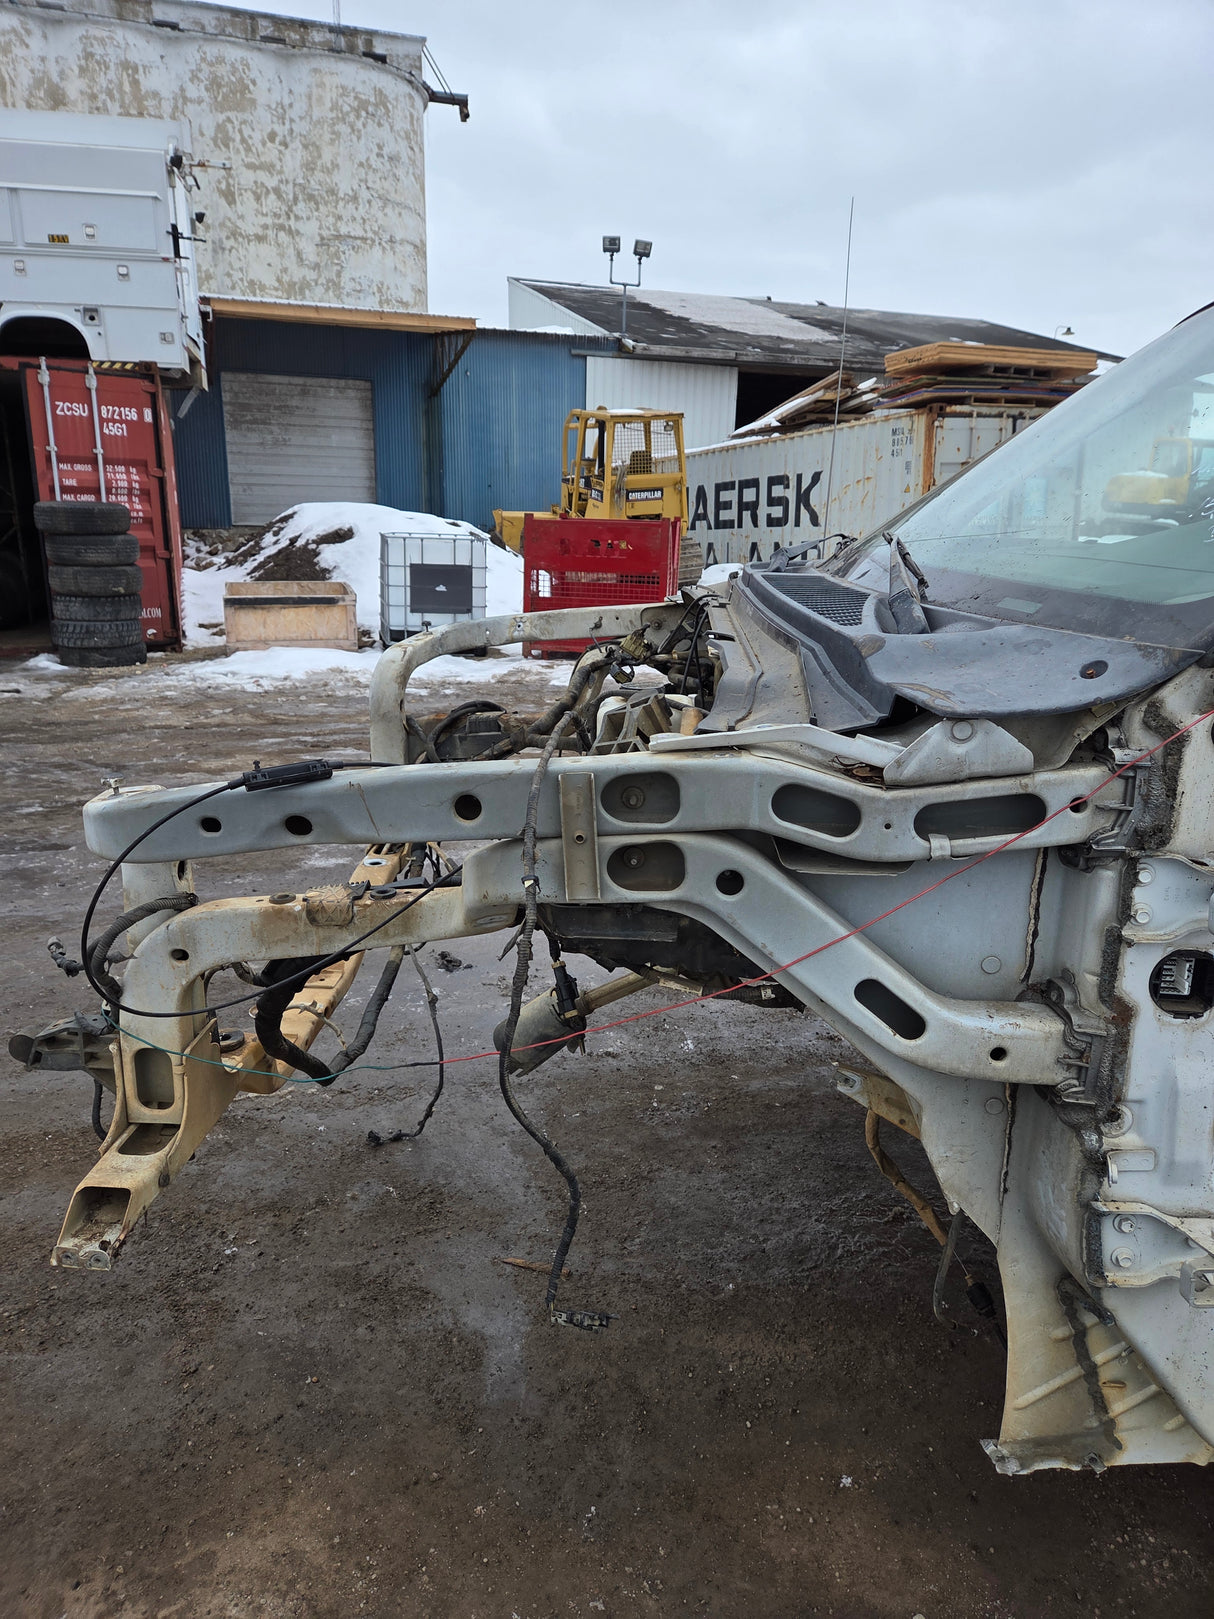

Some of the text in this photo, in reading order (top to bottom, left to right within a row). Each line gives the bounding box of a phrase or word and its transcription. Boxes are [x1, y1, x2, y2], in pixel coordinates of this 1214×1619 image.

[55, 401, 89, 417] ZCSU
[100, 405, 138, 421] 872156
[103, 422, 127, 437] 45G1
[62, 478, 78, 487] TARE
[76, 494, 96, 502] CARGO
[628, 490, 662, 500] CATERPILLAR
[686, 470, 823, 531] AERSK
